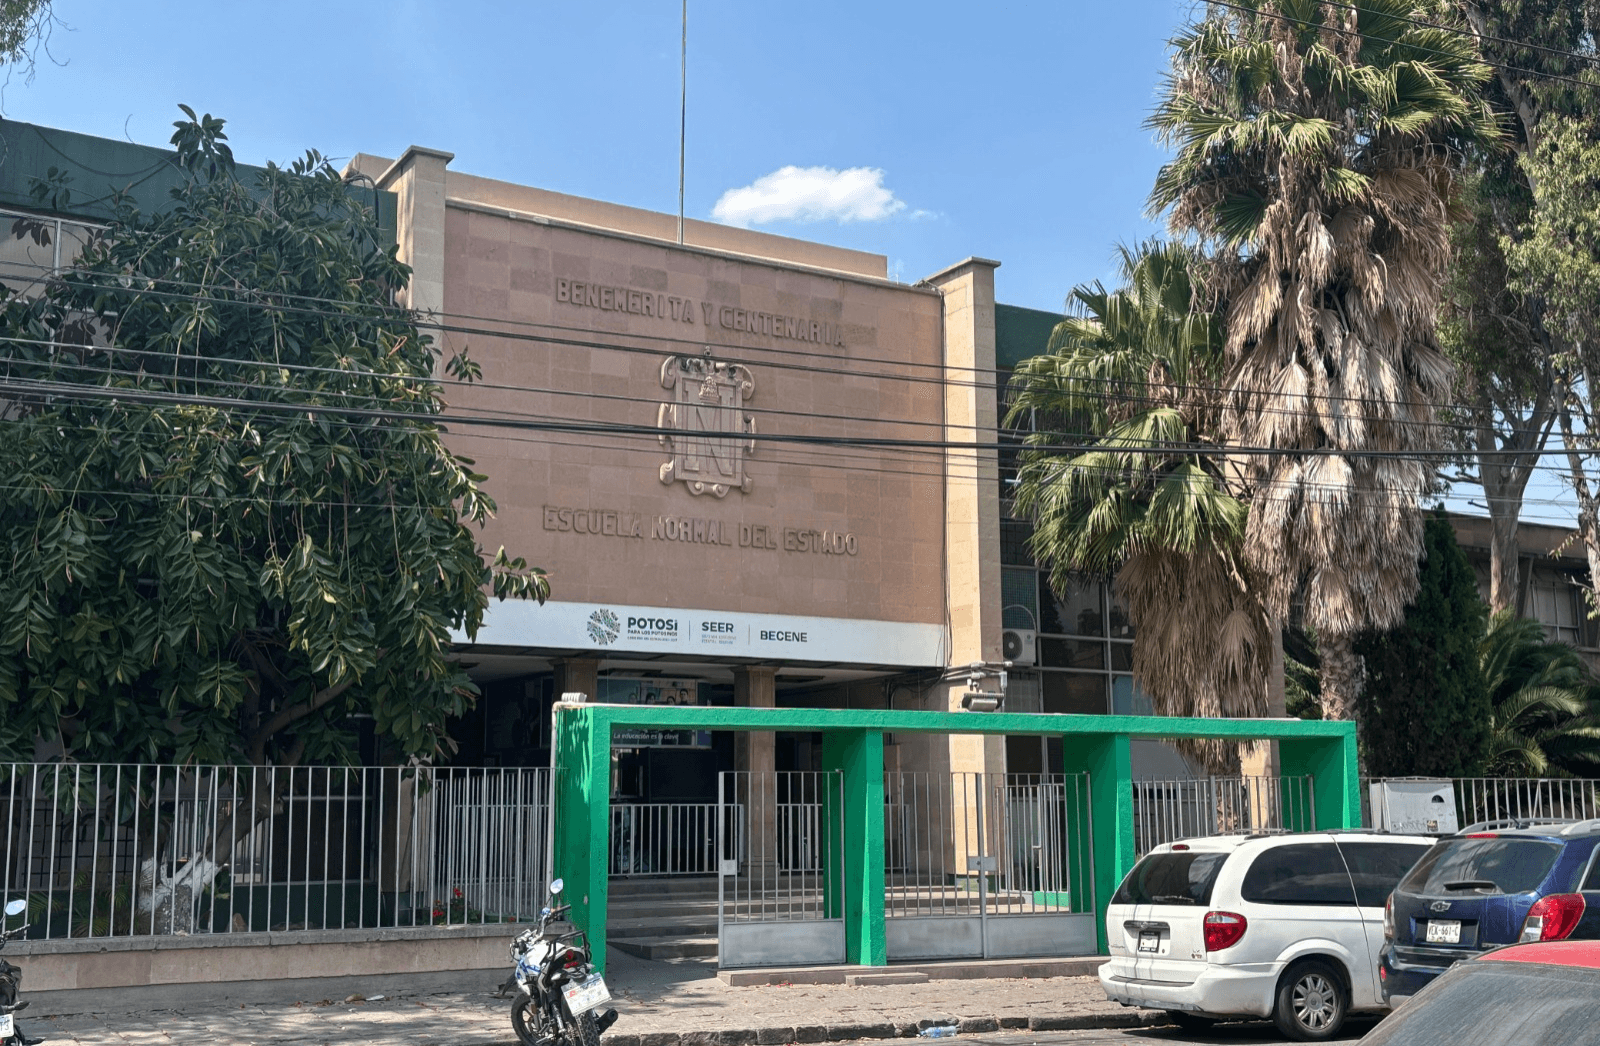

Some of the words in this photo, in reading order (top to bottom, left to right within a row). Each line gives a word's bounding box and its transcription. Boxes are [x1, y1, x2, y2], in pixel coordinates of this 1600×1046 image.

[555, 278, 694, 324] BENEMERITA
[700, 301, 713, 326] Y
[719, 306, 846, 348] CENTENARIA
[542, 505, 644, 539] ESCUELA
[651, 515, 732, 546] NORMAL
[738, 523, 778, 549] DEL
[783, 527, 859, 556] ESTADO
[701, 621, 734, 633] SEER
[760, 630, 808, 643] BECENE
